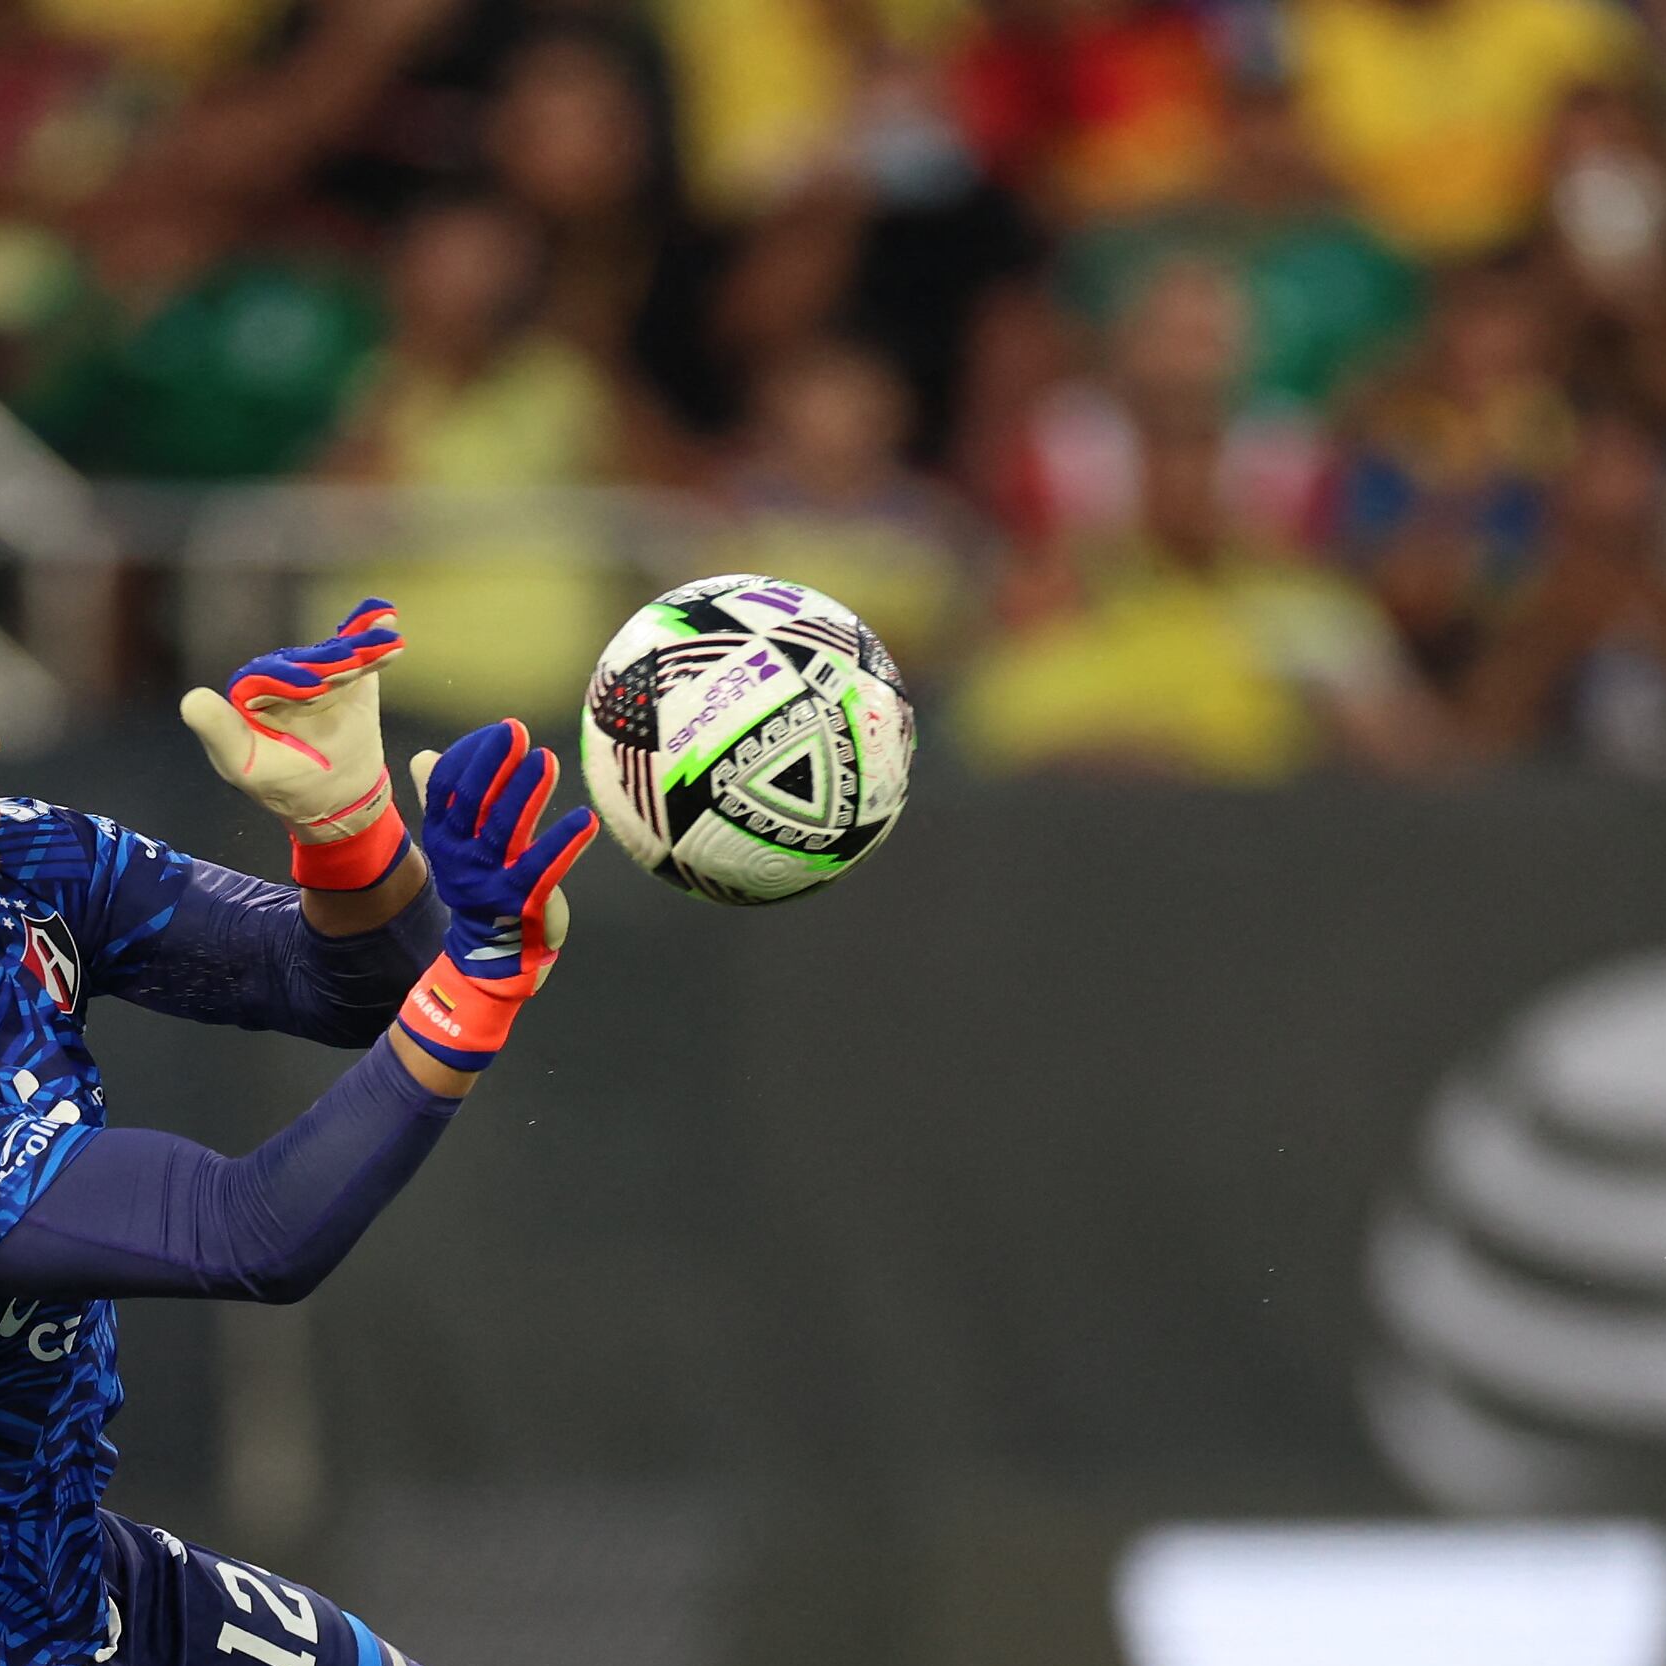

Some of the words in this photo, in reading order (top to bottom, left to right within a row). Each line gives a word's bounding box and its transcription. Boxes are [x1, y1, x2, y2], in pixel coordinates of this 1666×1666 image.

[704, 667, 746, 701] CUP
[667, 677, 757, 753] LEAGUES
[412, 988, 462, 1038] VARGAS
